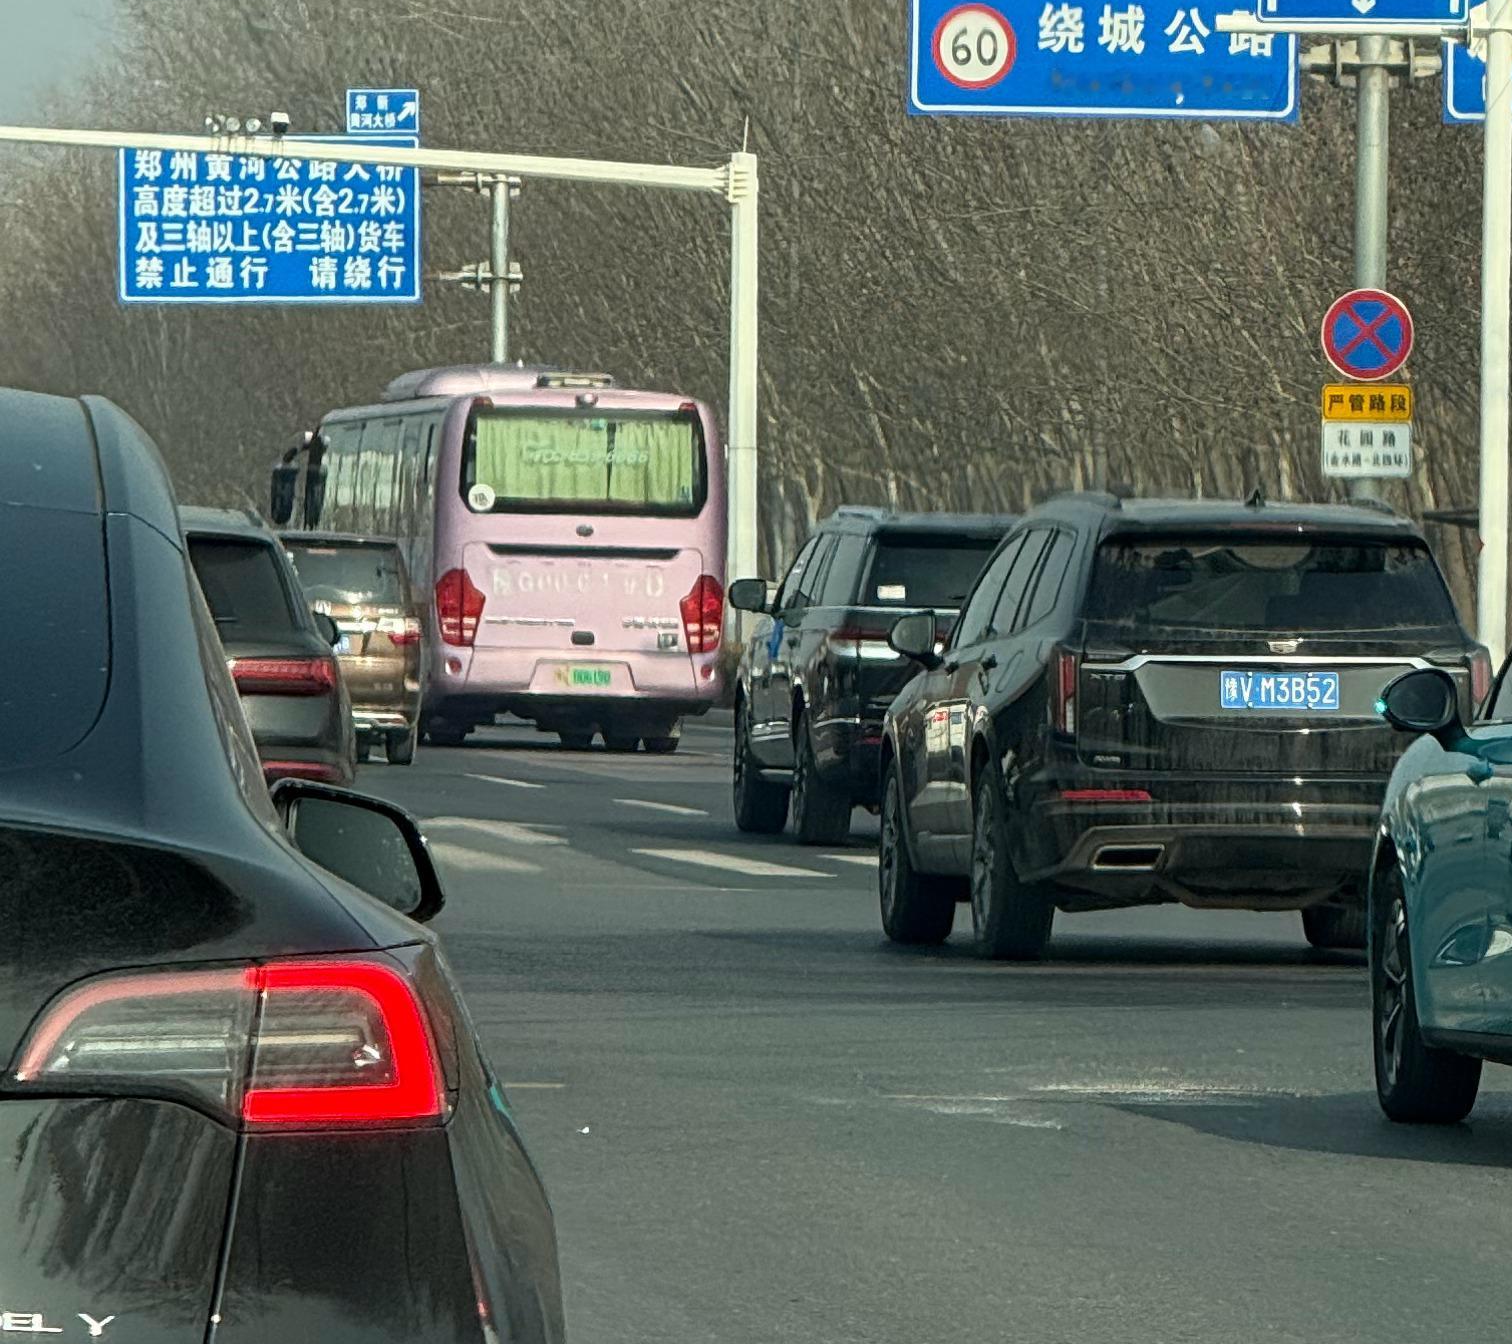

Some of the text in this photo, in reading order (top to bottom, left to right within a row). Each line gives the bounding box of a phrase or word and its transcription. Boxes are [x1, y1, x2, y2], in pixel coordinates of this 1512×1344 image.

[1038, 2, 1273, 57] 绕城公路
[951, 28, 998, 67] 60
[135, 256, 406, 290] 禁止通行 请绕行
[1328, 393, 1407, 413] 严管路段
[0, 1312, 116, 1336] EL Y
